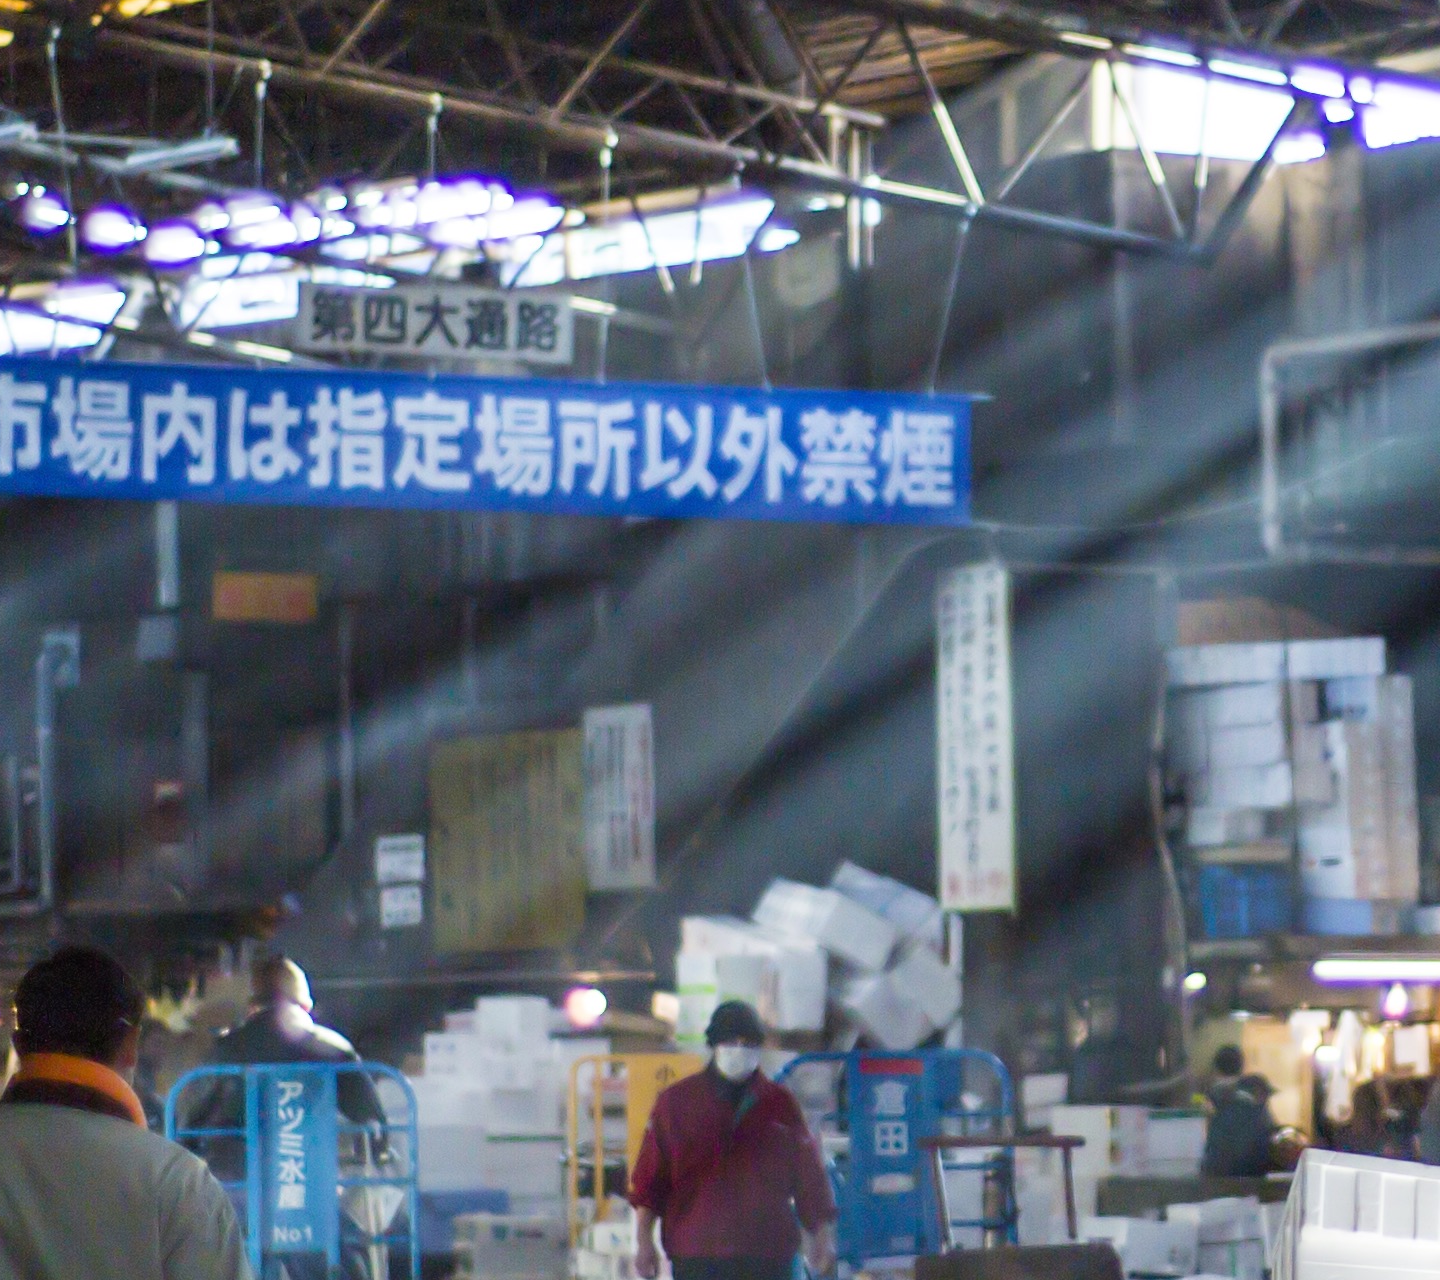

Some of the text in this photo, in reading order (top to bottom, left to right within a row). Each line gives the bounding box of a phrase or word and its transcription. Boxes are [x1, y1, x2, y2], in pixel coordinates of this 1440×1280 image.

[308, 290, 564, 356] 第四大通路
